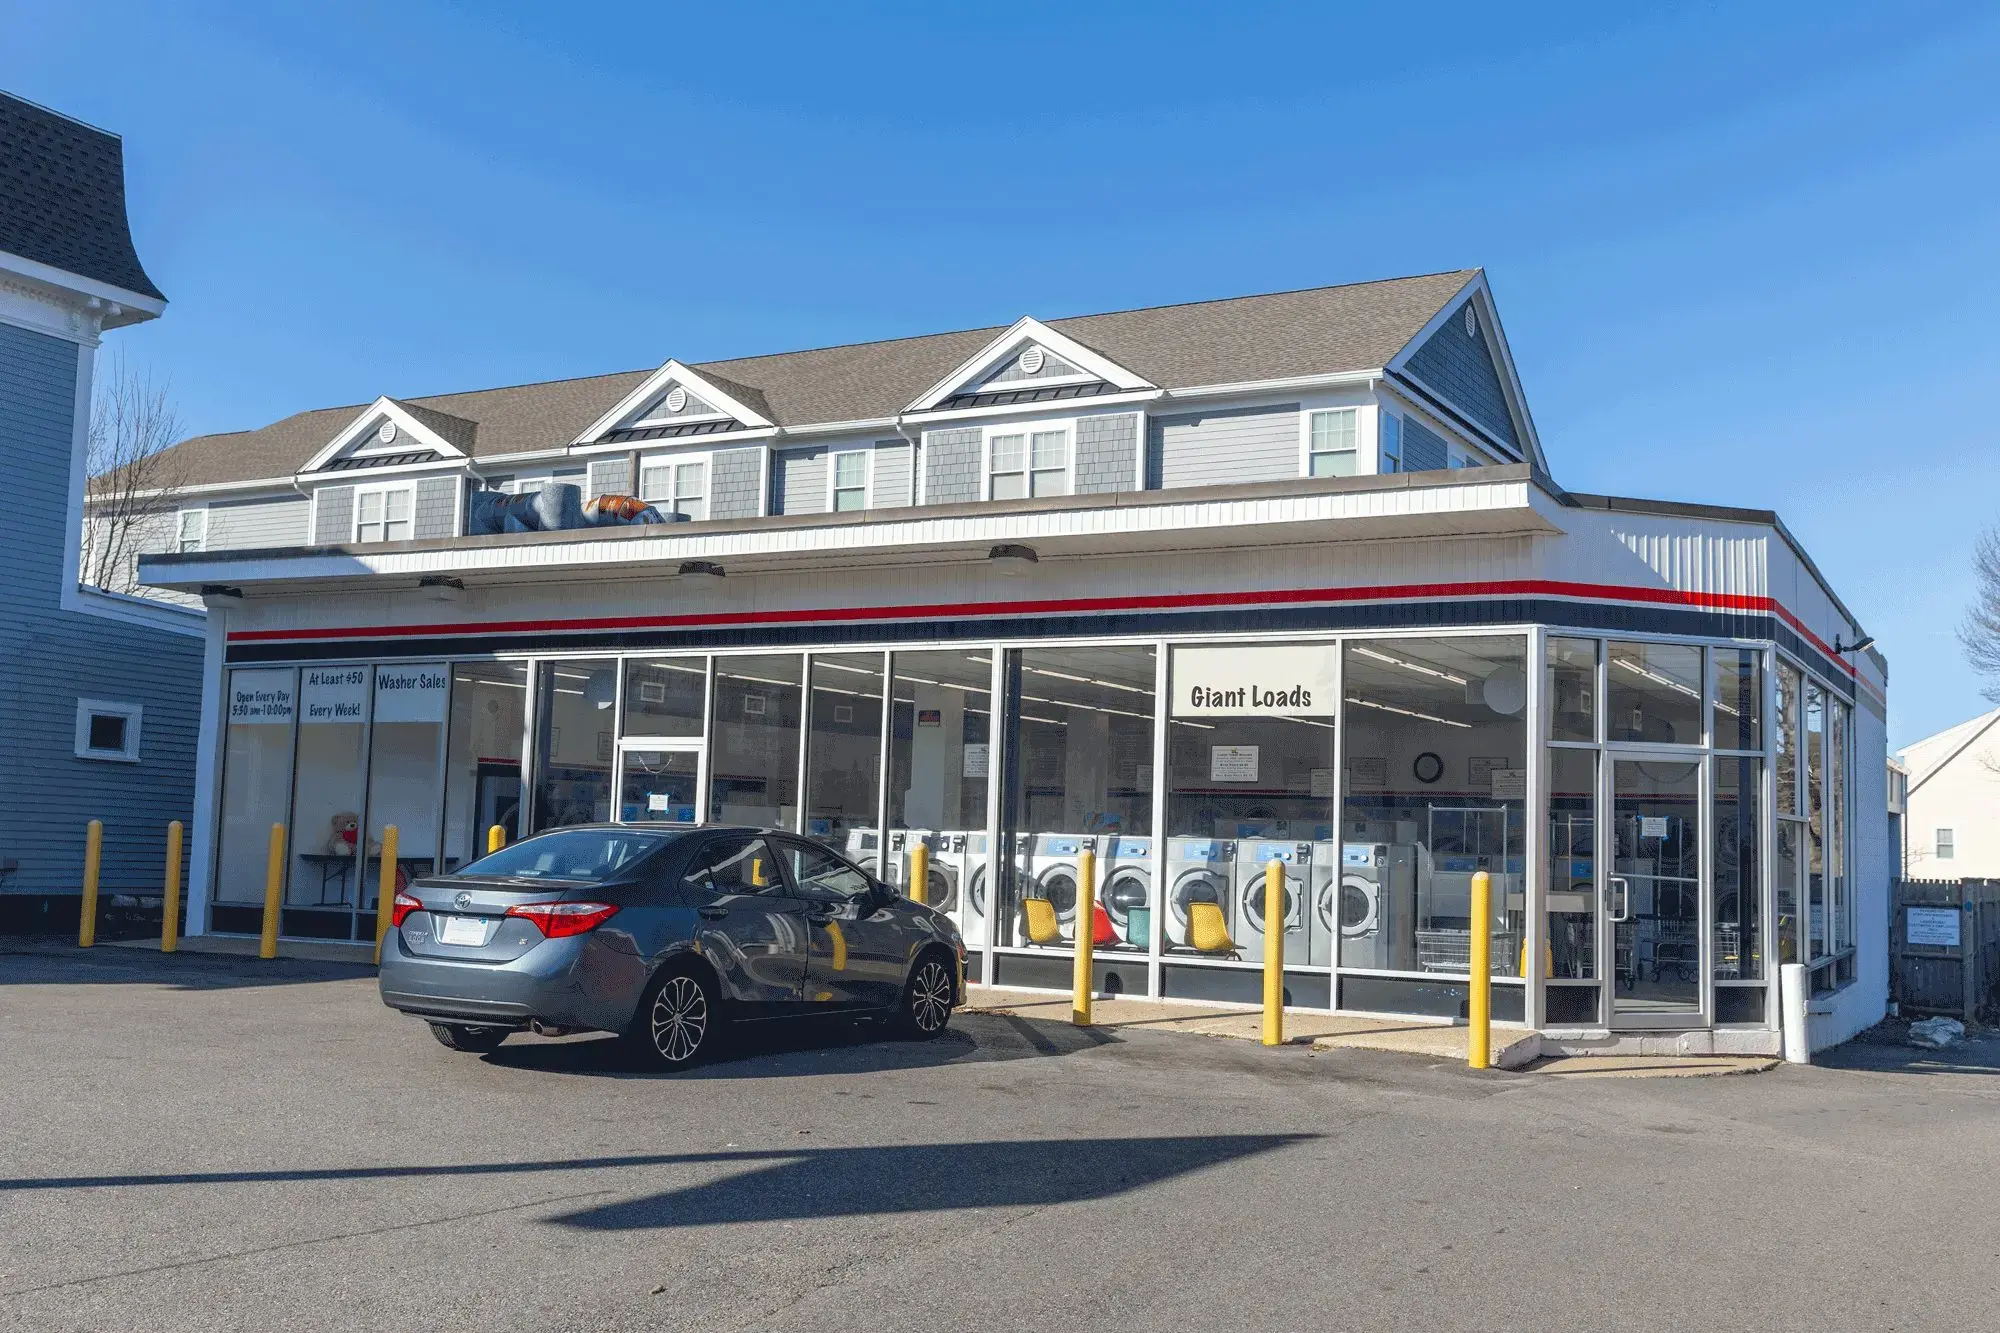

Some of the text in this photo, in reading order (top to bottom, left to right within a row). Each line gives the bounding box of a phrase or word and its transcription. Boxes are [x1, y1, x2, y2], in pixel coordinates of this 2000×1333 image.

[309, 671, 364, 686] At Least $50
[378, 673, 446, 690] Washer Sales
[236, 690, 290, 705] Open Every Day
[1191, 684, 1312, 708] Giant Loads
[309, 702, 361, 719] Every Week!
